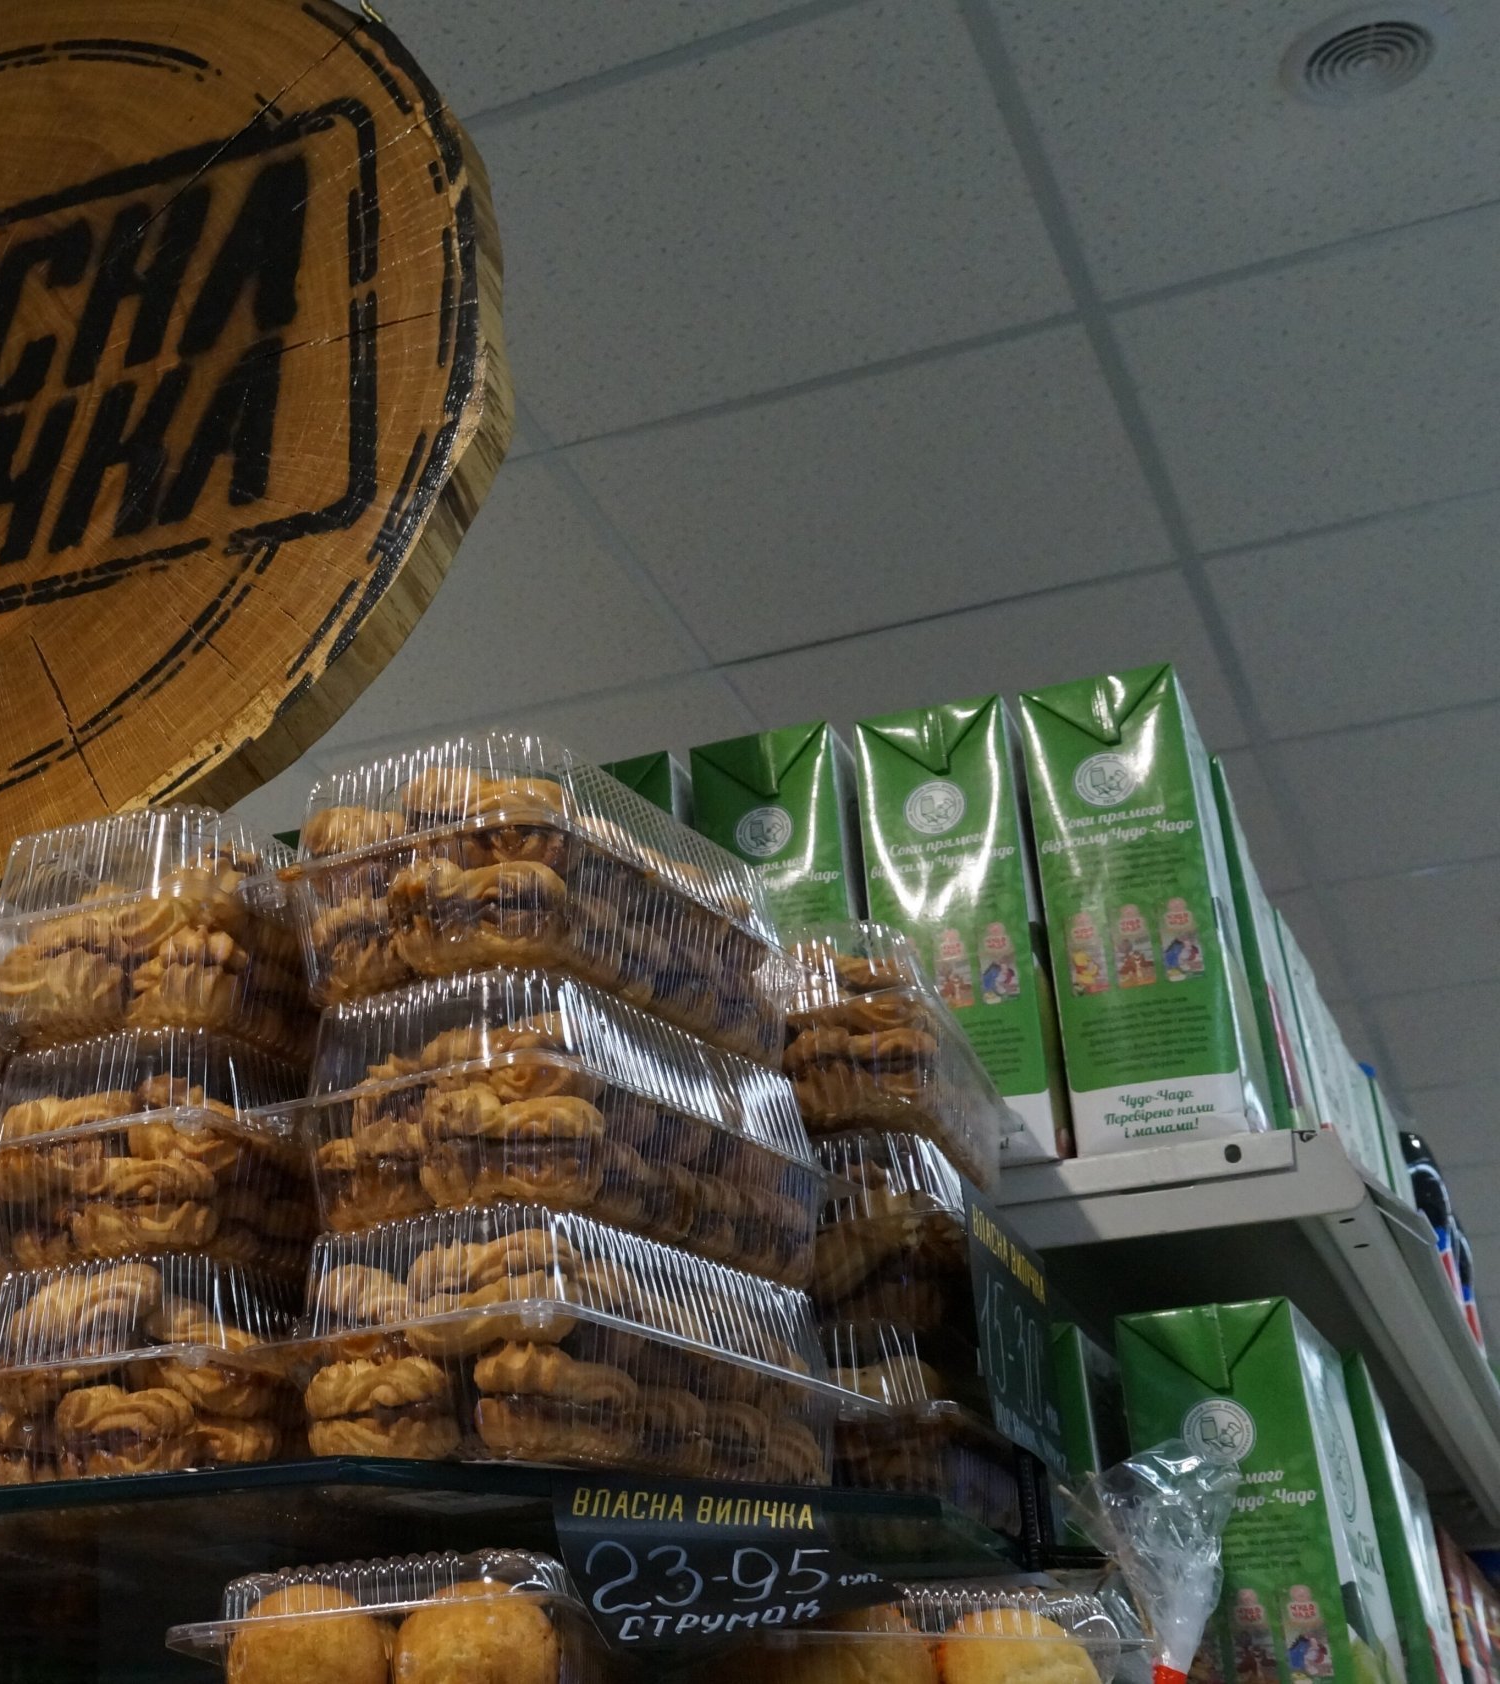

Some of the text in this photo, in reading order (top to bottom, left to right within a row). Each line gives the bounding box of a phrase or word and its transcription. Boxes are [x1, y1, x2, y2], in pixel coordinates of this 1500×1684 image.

[1098, 805, 1165, 826] прямого
[889, 844, 923, 857] Соки
[1104, 1103, 1214, 1127] Перевірено нами
[1132, 1117, 1199, 1138] мамами!
[972, 1203, 1009, 1269] ВЛАСНА
[572, 1487, 814, 1530] ВЛАСНА ВИПІЧКА
[585, 1540, 831, 1614] 23-95
[618, 1600, 821, 1642] СТРУМОК
